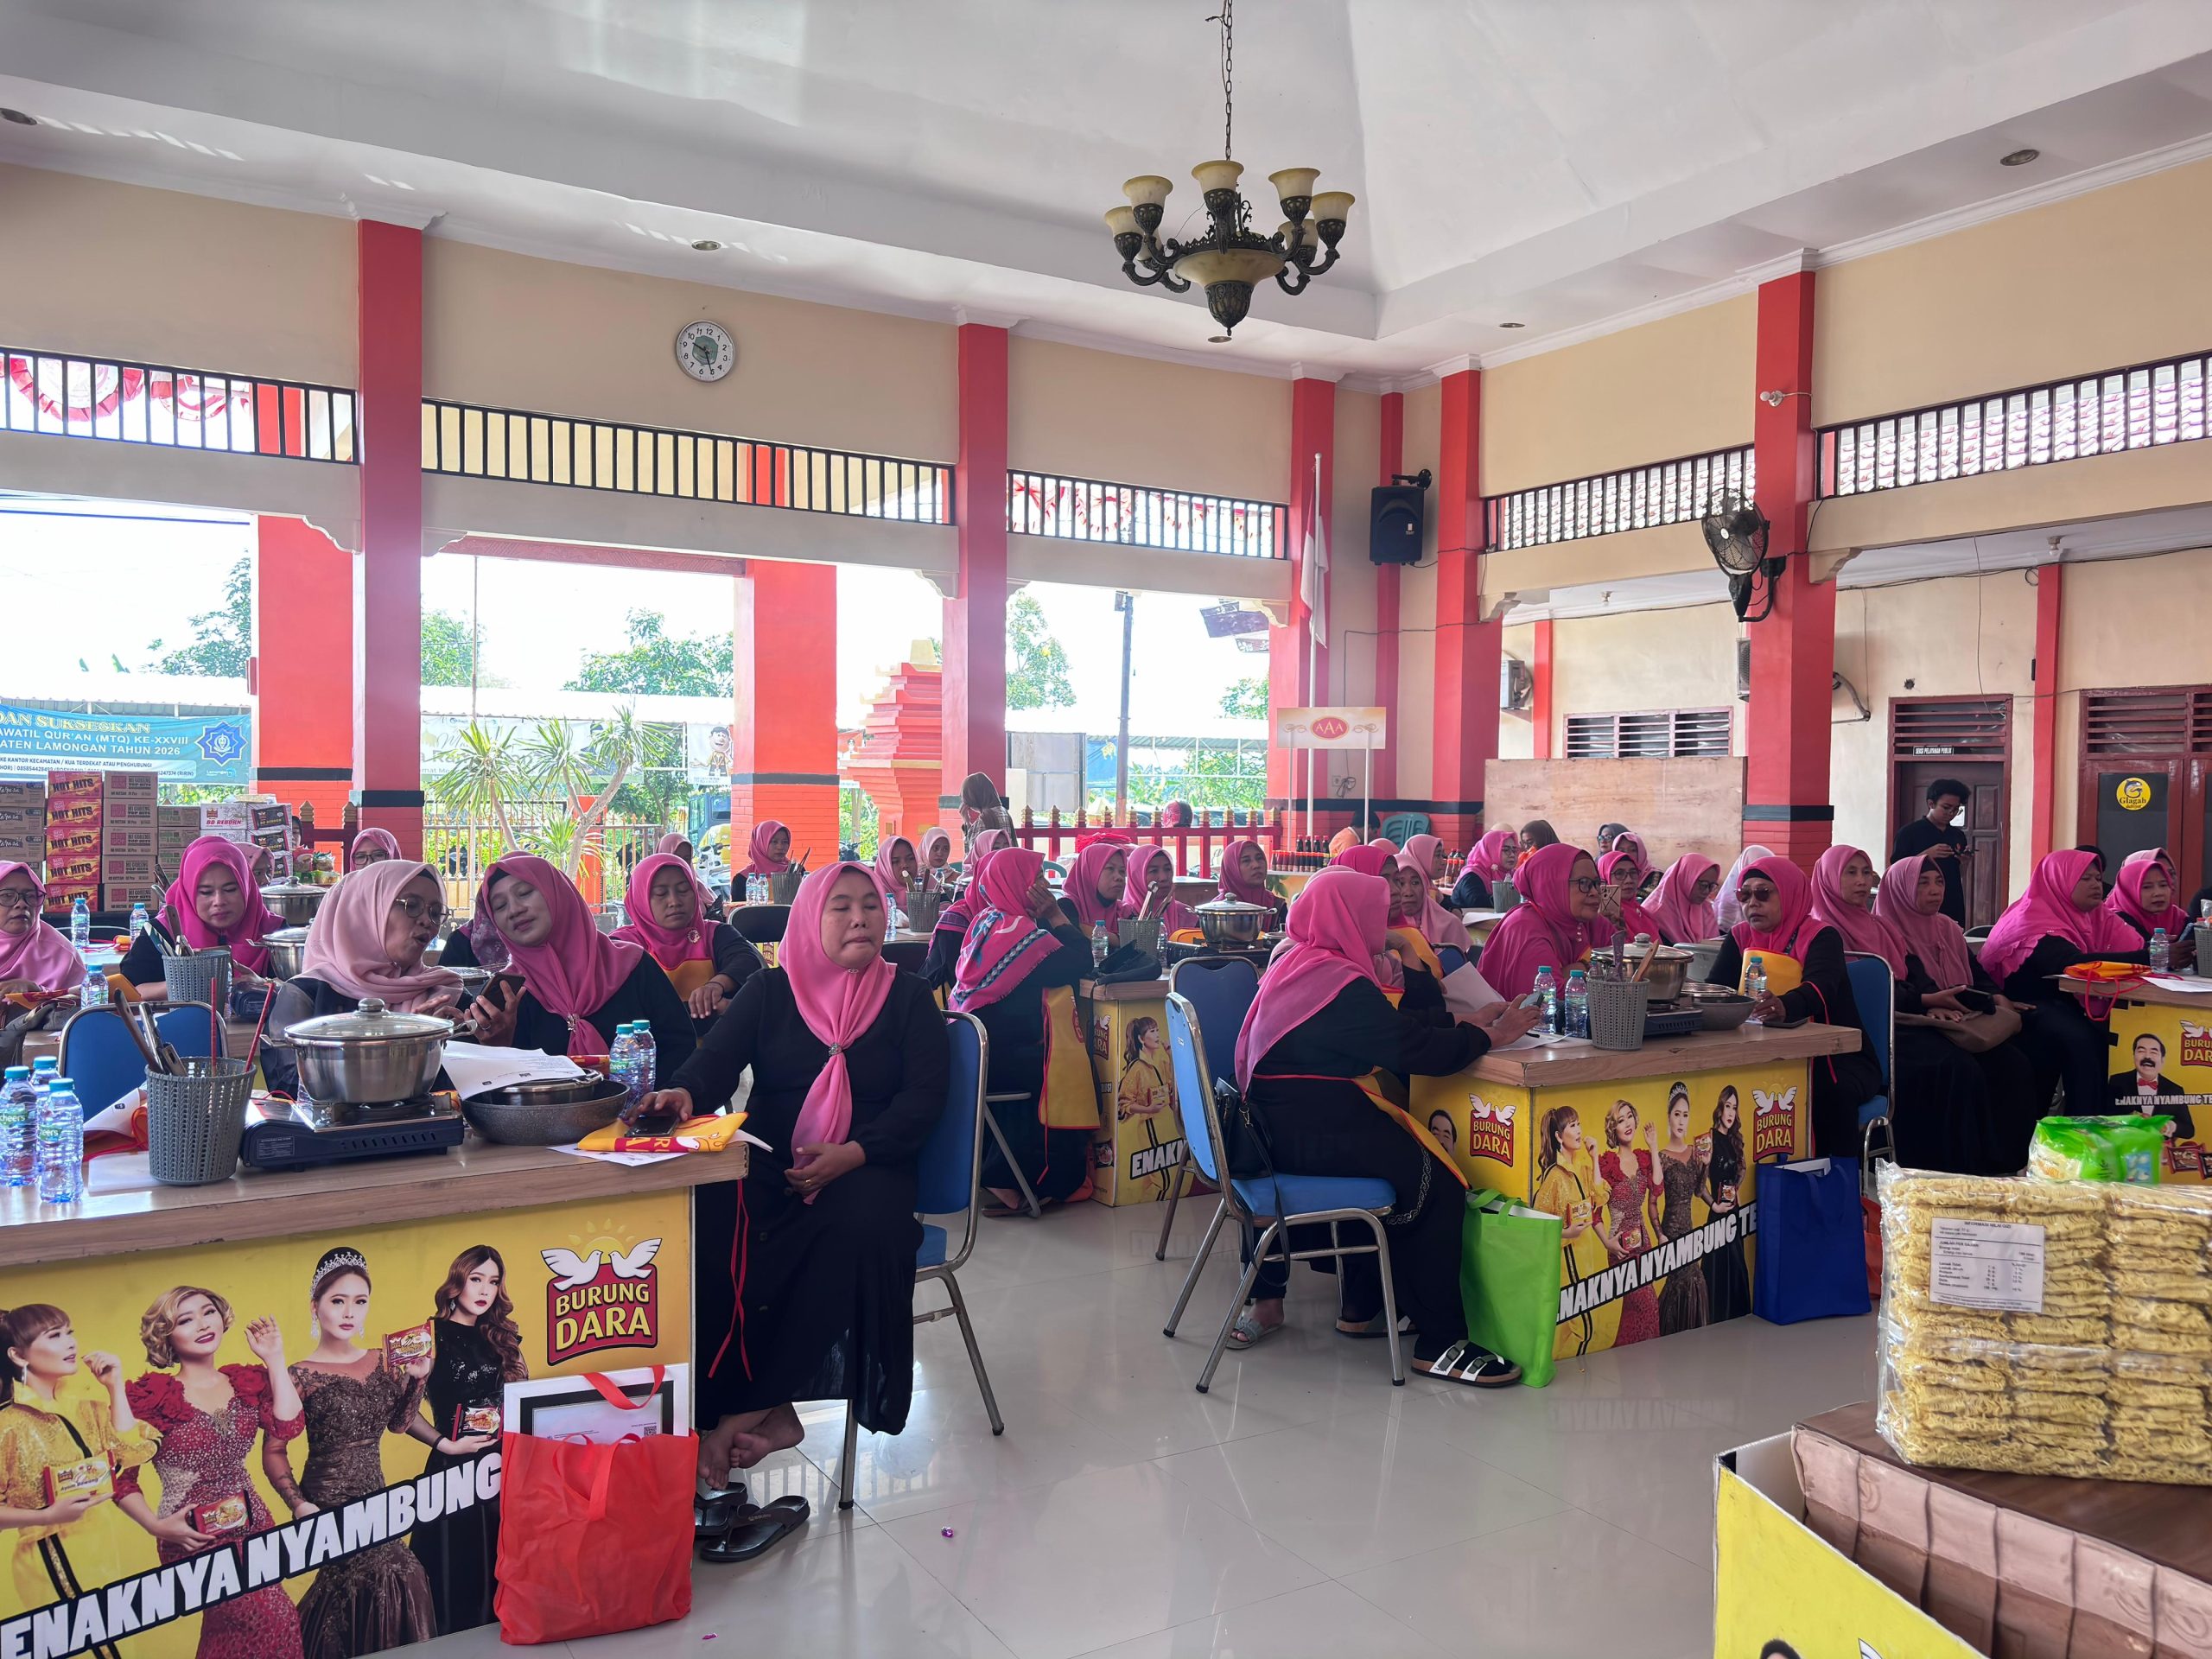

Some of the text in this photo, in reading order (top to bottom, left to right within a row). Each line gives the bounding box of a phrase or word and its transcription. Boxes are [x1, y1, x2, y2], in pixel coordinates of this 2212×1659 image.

[1315, 721, 1344, 734] AAA
[44, 730, 92, 741] QUR'AN
[95, 734, 130, 744] (MTQ)
[134, 735, 188, 745] KE-XXVIII
[36, 741, 106, 753] LAMONGAN
[111, 745, 150, 754] TAHUN
[155, 747, 181, 755] 2026
[53, 778, 93, 791] HOT HITS
[52, 806, 92, 821] HOT HITS
[51, 835, 92, 849] HOT HITS
[51, 863, 92, 877] HOT HITS
[1095, 1029, 1108, 1040] UNG
[1093, 1039, 1108, 1052] ARA
[2184, 1039, 2212, 1048] BURU
[2154, 1094, 2202, 1104] NYAMBUNG
[1757, 1114, 1792, 1132] BURUNG
[1473, 1122, 1510, 1140] BURUNG
[1473, 1134, 1510, 1159] DARA
[1757, 1128, 1792, 1154] DARA
[1557, 1260, 1638, 1322] NAKNYA
[1641, 1214, 1738, 1285] NYAMBUNG
[556, 1283, 650, 1317] BURUNG
[556, 1306, 652, 1351] DARA
[0, 1452, 501, 1659] ENAKNYA NYAMBUNG
